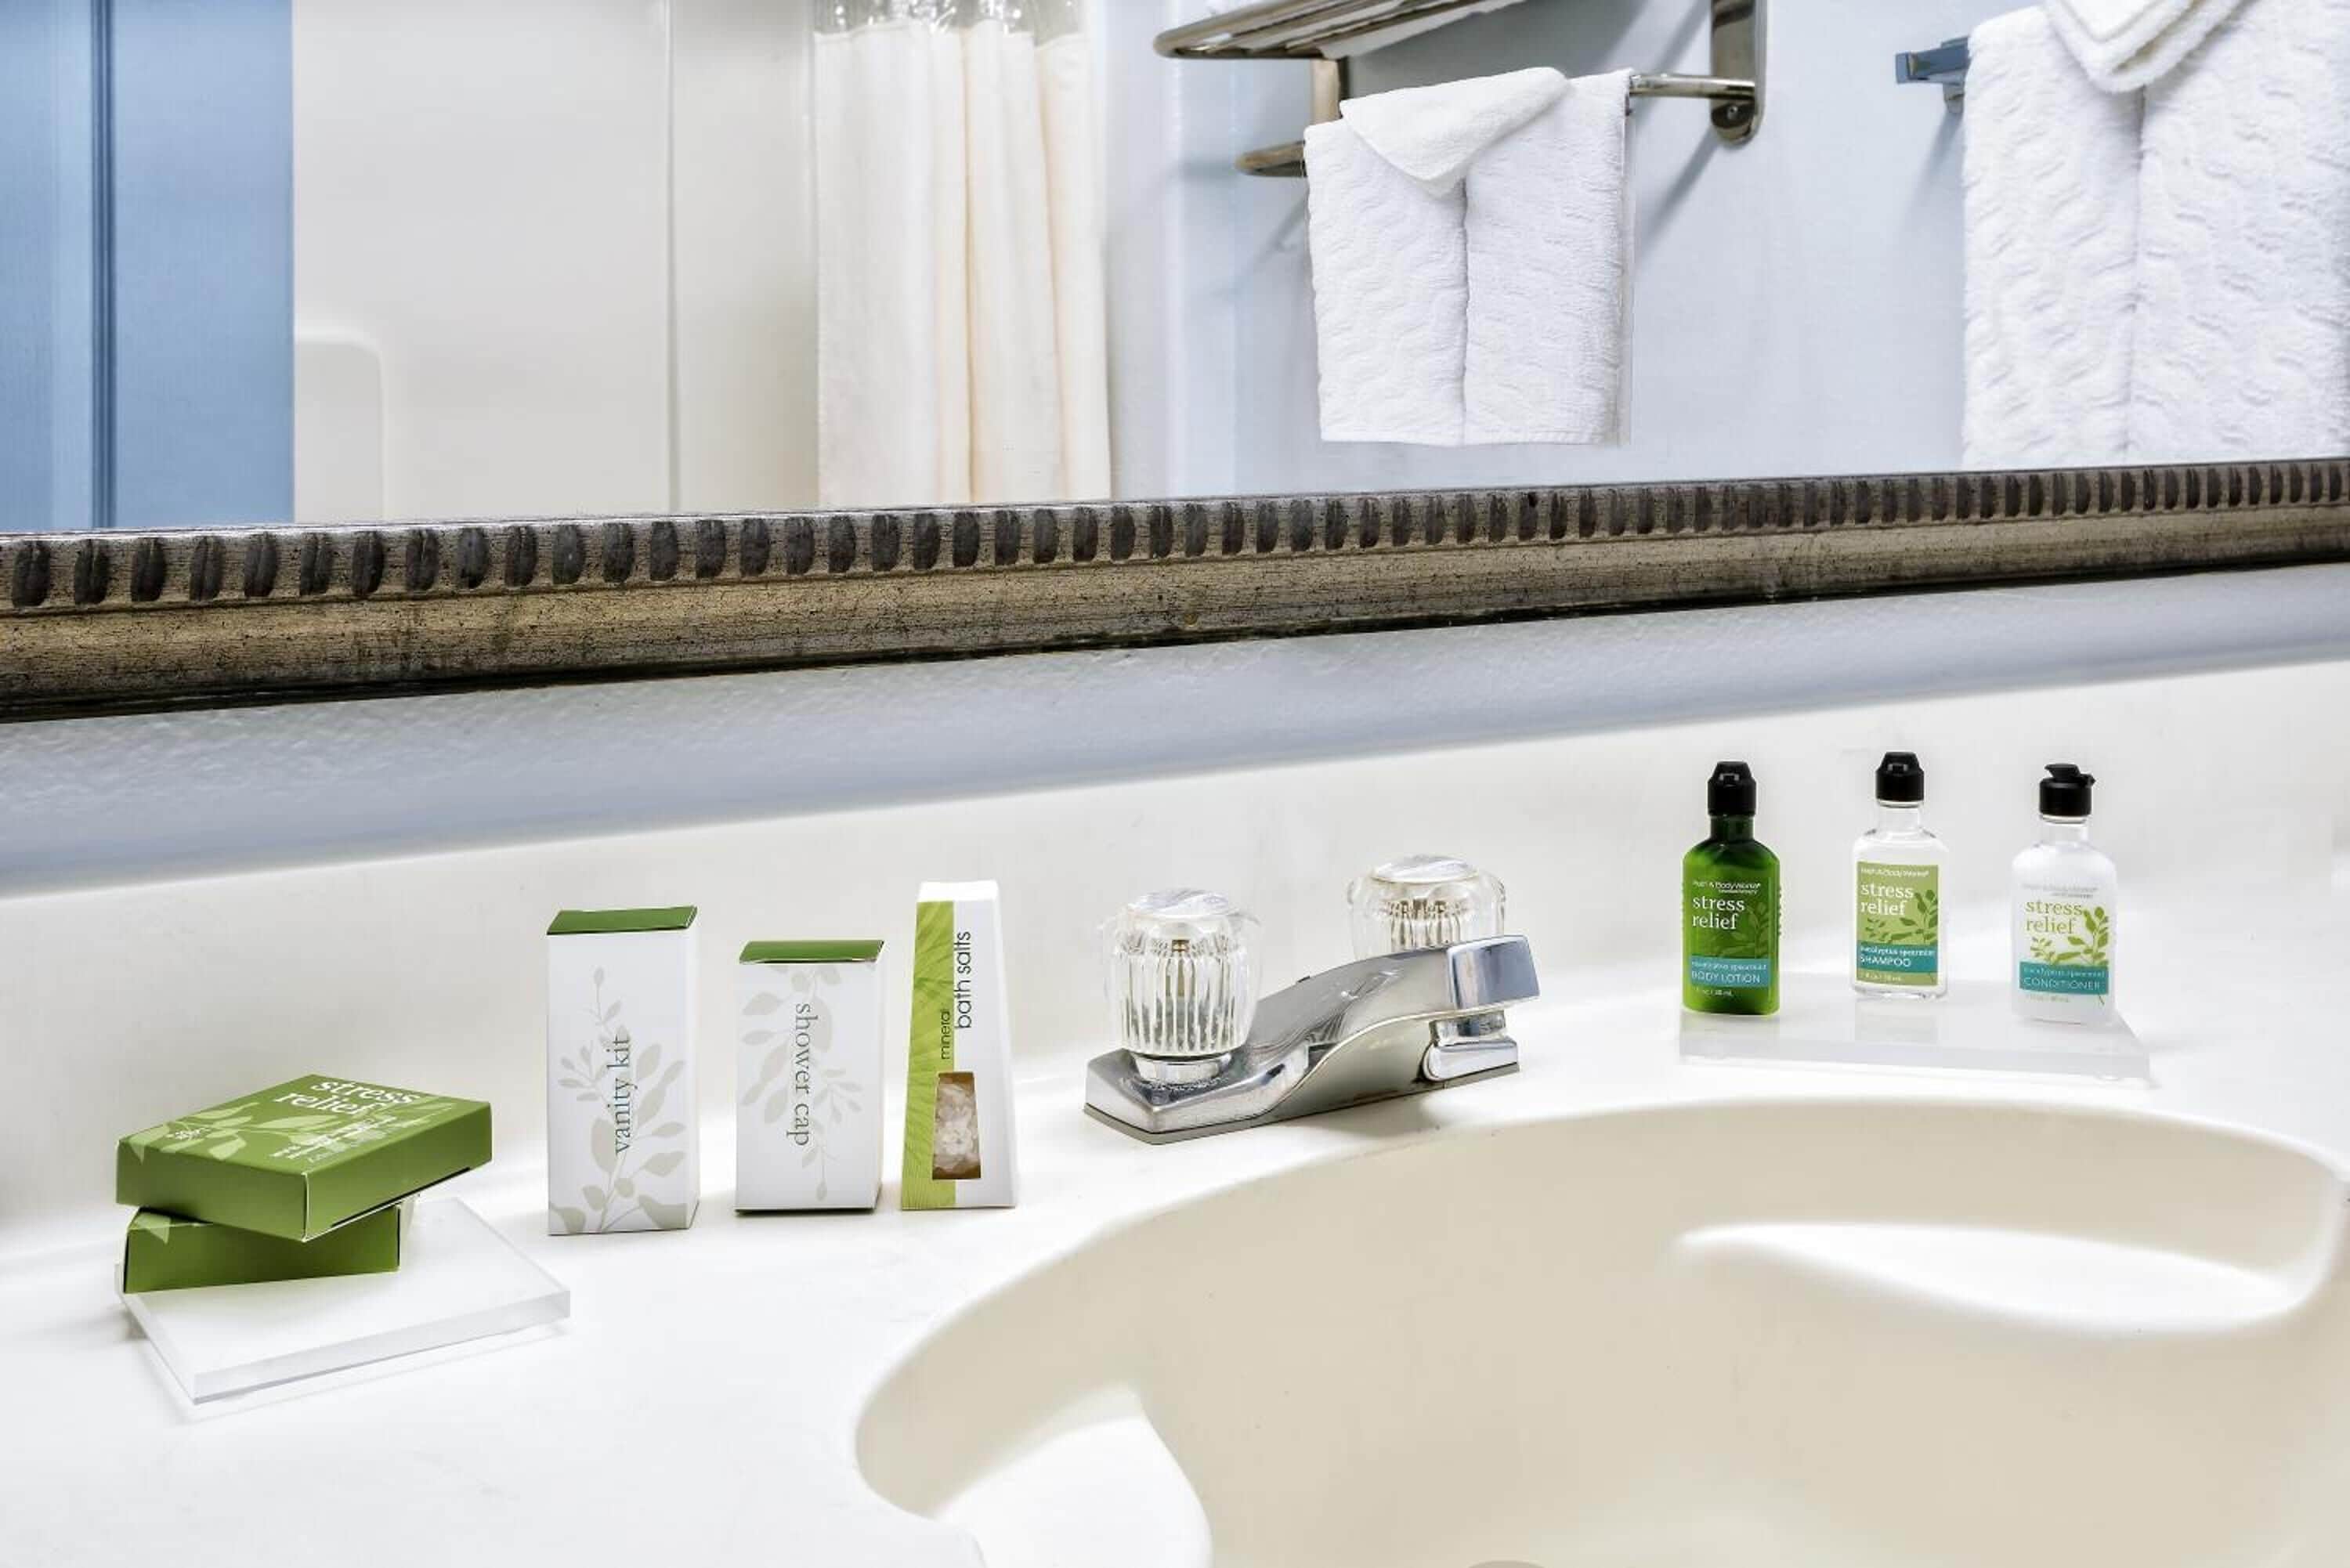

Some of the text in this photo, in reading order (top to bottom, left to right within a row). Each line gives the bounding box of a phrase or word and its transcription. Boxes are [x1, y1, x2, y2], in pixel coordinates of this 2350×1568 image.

[1860, 883, 1914, 898] stress
[1693, 896, 1745, 911] stress
[1860, 898, 1908, 916] relief
[2025, 900, 2083, 916] stress
[1692, 912, 1740, 930] relief
[2026, 916, 2076, 934] relief
[1860, 955, 1912, 967] SHAMPOO
[953, 930, 972, 1029] bath salts
[1691, 970, 1761, 984] BODY LOTION
[786, 1003, 819, 1147] shower cap
[310, 1081, 421, 1104] stress
[606, 1034, 638, 1155] vanity kit
[274, 1092, 387, 1115] relief
